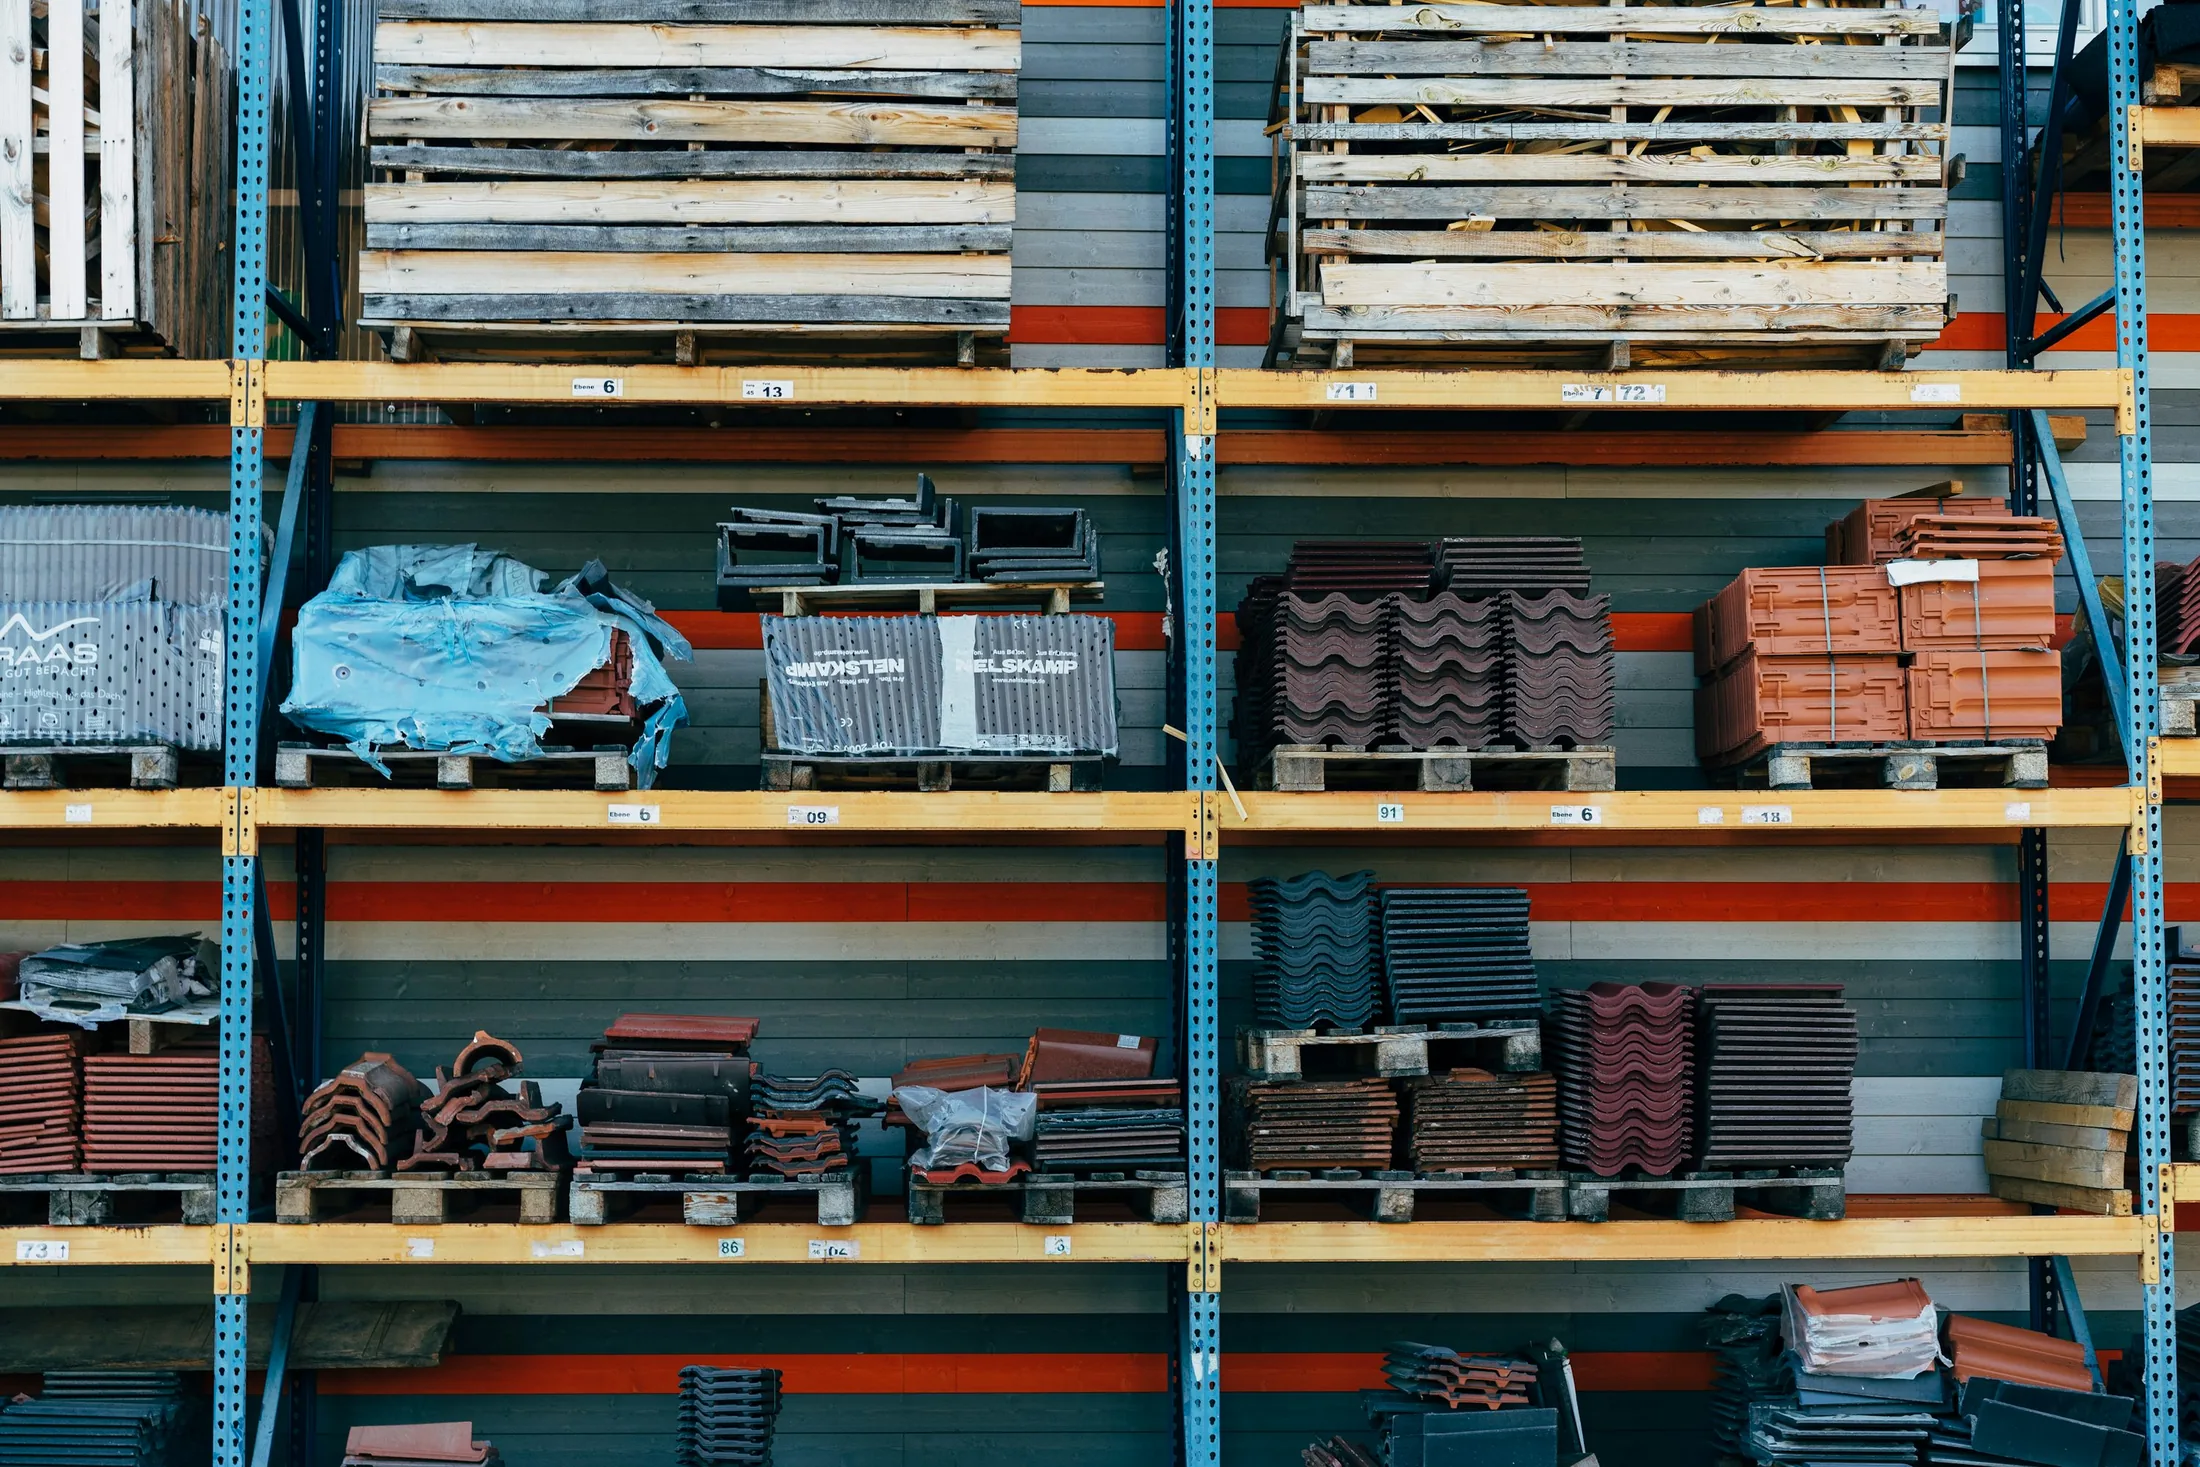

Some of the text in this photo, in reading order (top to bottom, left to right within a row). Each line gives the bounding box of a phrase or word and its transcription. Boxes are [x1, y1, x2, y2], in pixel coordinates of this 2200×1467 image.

[603, 380, 615, 393] 6
[762, 386, 783, 398] 13
[1620, 386, 1646, 401] 72
[5, 665, 98, 678] GUT BEDACHT
[785, 658, 905, 677] NELSKAMP
[24, 688, 62, 699] Hightech
[81, 689, 95, 699] das
[639, 807, 651, 821] 6
[807, 811, 827, 824] 09
[1380, 806, 1396, 819] 91
[1581, 807, 1593, 821] 6
[22, 1243, 48, 1259] 73
[721, 1241, 739, 1254] 86
